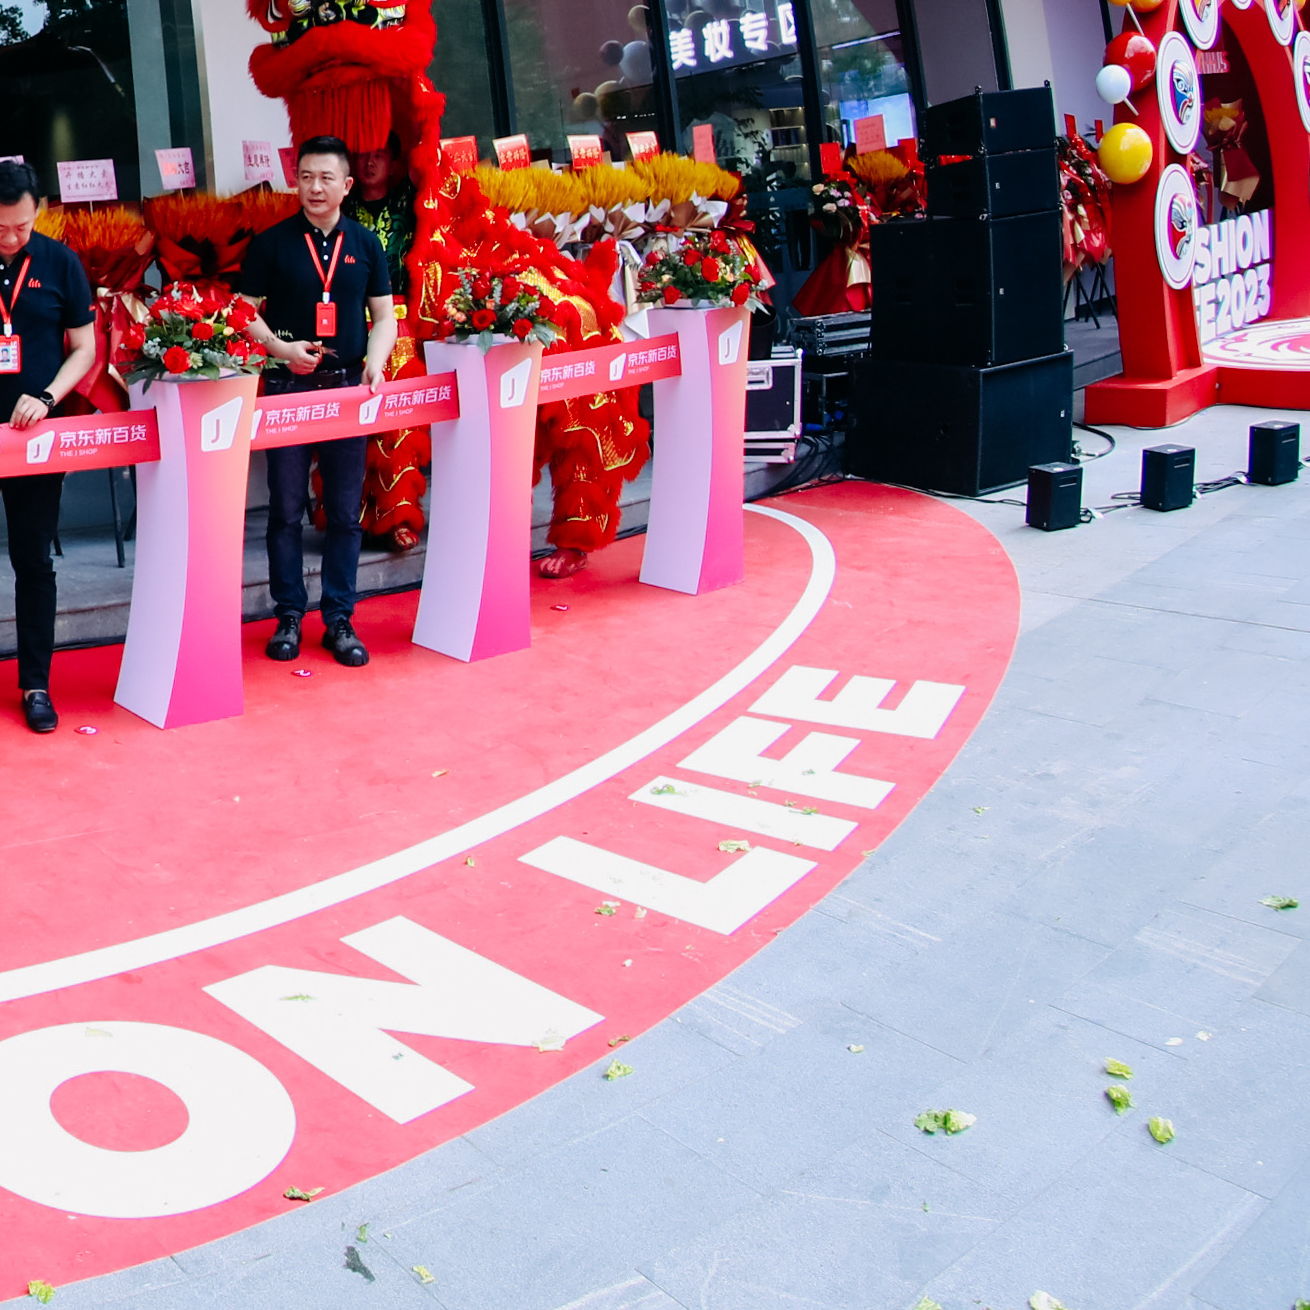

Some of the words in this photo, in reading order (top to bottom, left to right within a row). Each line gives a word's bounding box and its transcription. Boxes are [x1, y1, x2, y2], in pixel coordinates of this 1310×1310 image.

[669, 2, 798, 70] 美妆专区
[1194, 209, 1272, 285] SHION
[628, 345, 677, 366] 京东新百货
[540, 361, 596, 383] 京东新百货
[384, 385, 452, 409] 京东新百货
[265, 402, 340, 425] 京东新百货
[59, 424, 146, 446] 京东新百货
[79, 448, 97, 456] SHOP
[517, 665, 965, 935] LIFE
